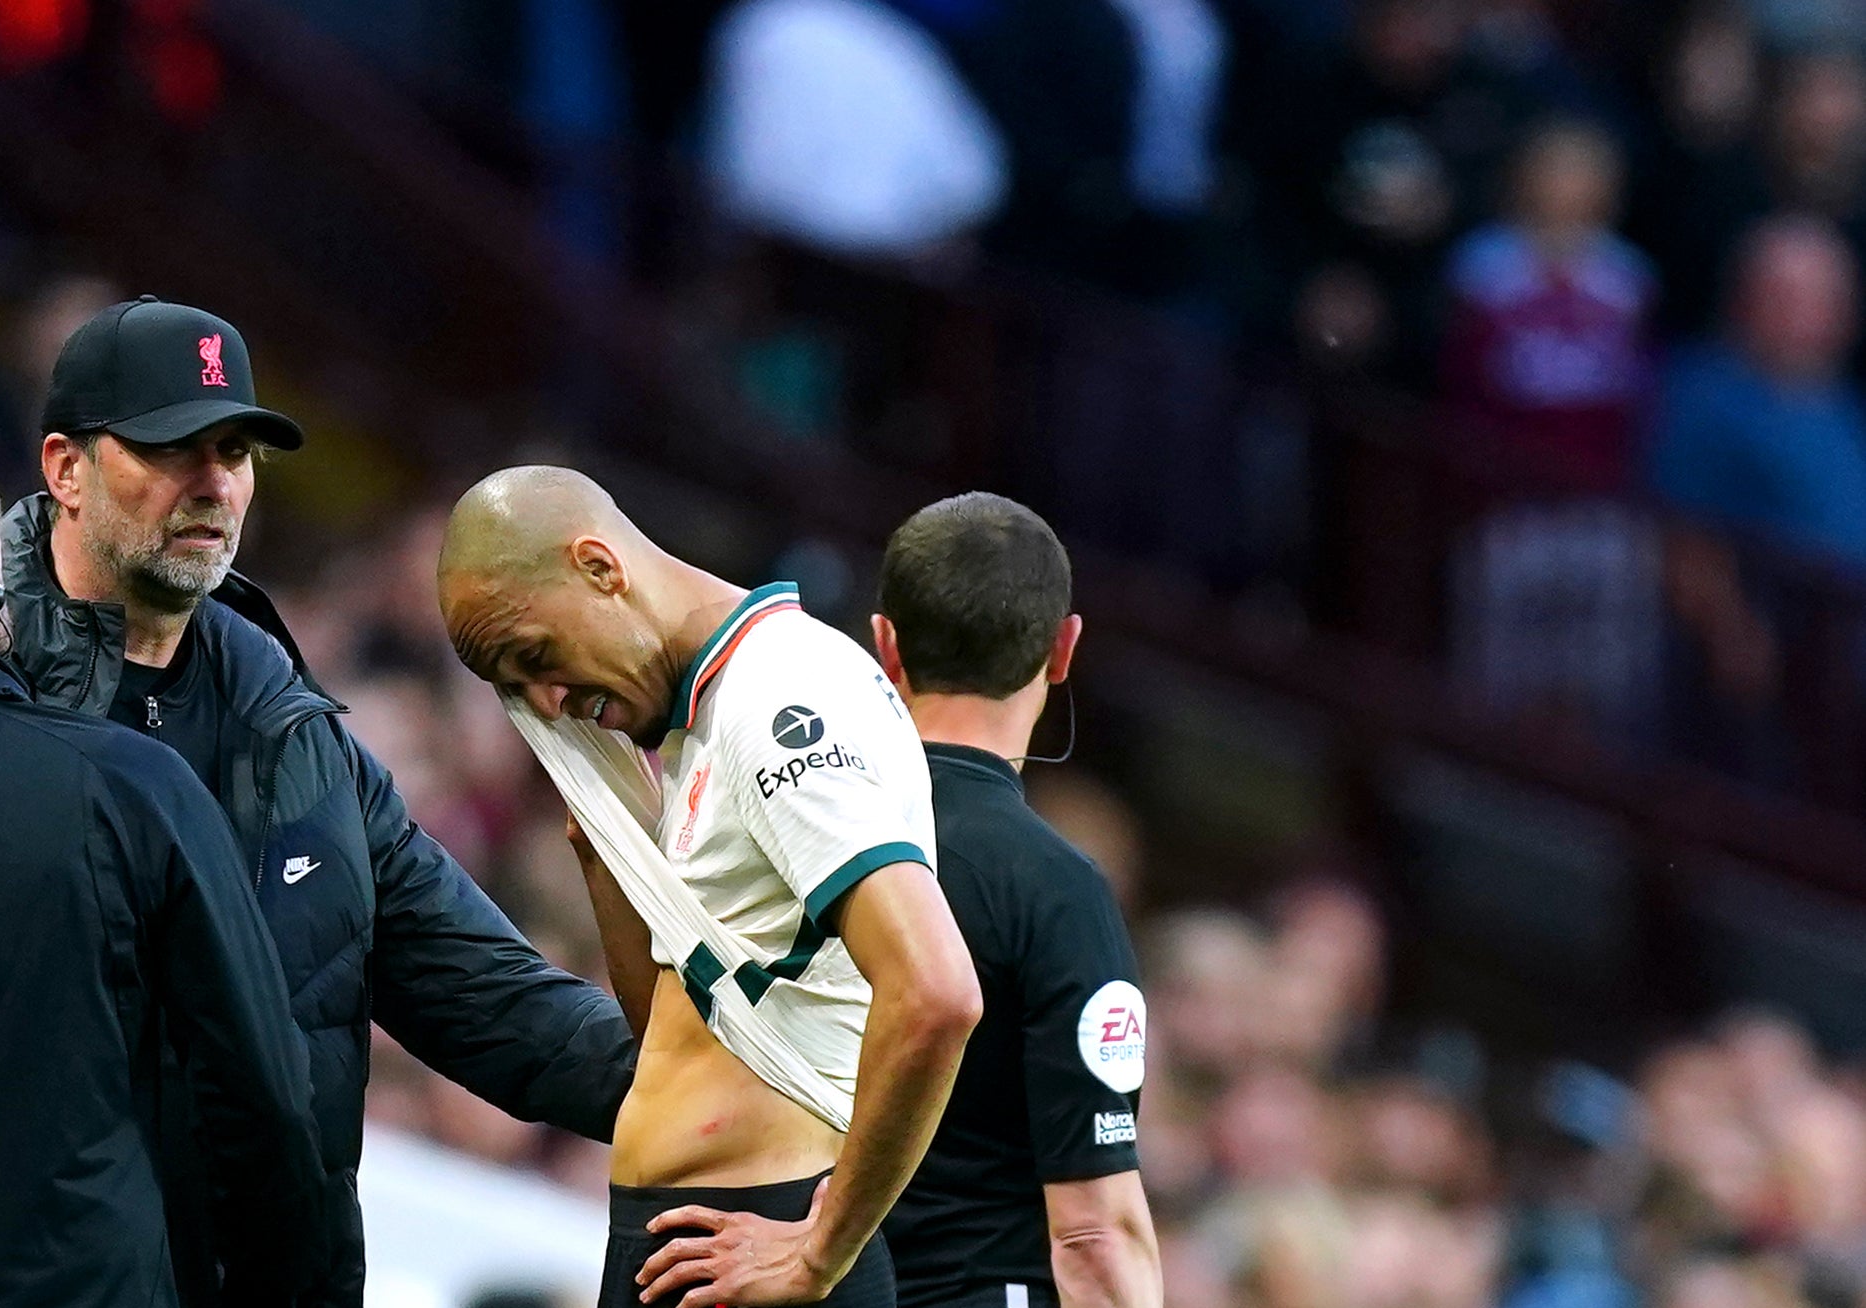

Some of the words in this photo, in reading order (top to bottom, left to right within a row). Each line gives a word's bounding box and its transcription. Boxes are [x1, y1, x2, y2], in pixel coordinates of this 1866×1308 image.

[755, 743, 866, 800] Expedia
[285, 855, 311, 873] NIKE
[1100, 1007, 1143, 1043] EA
